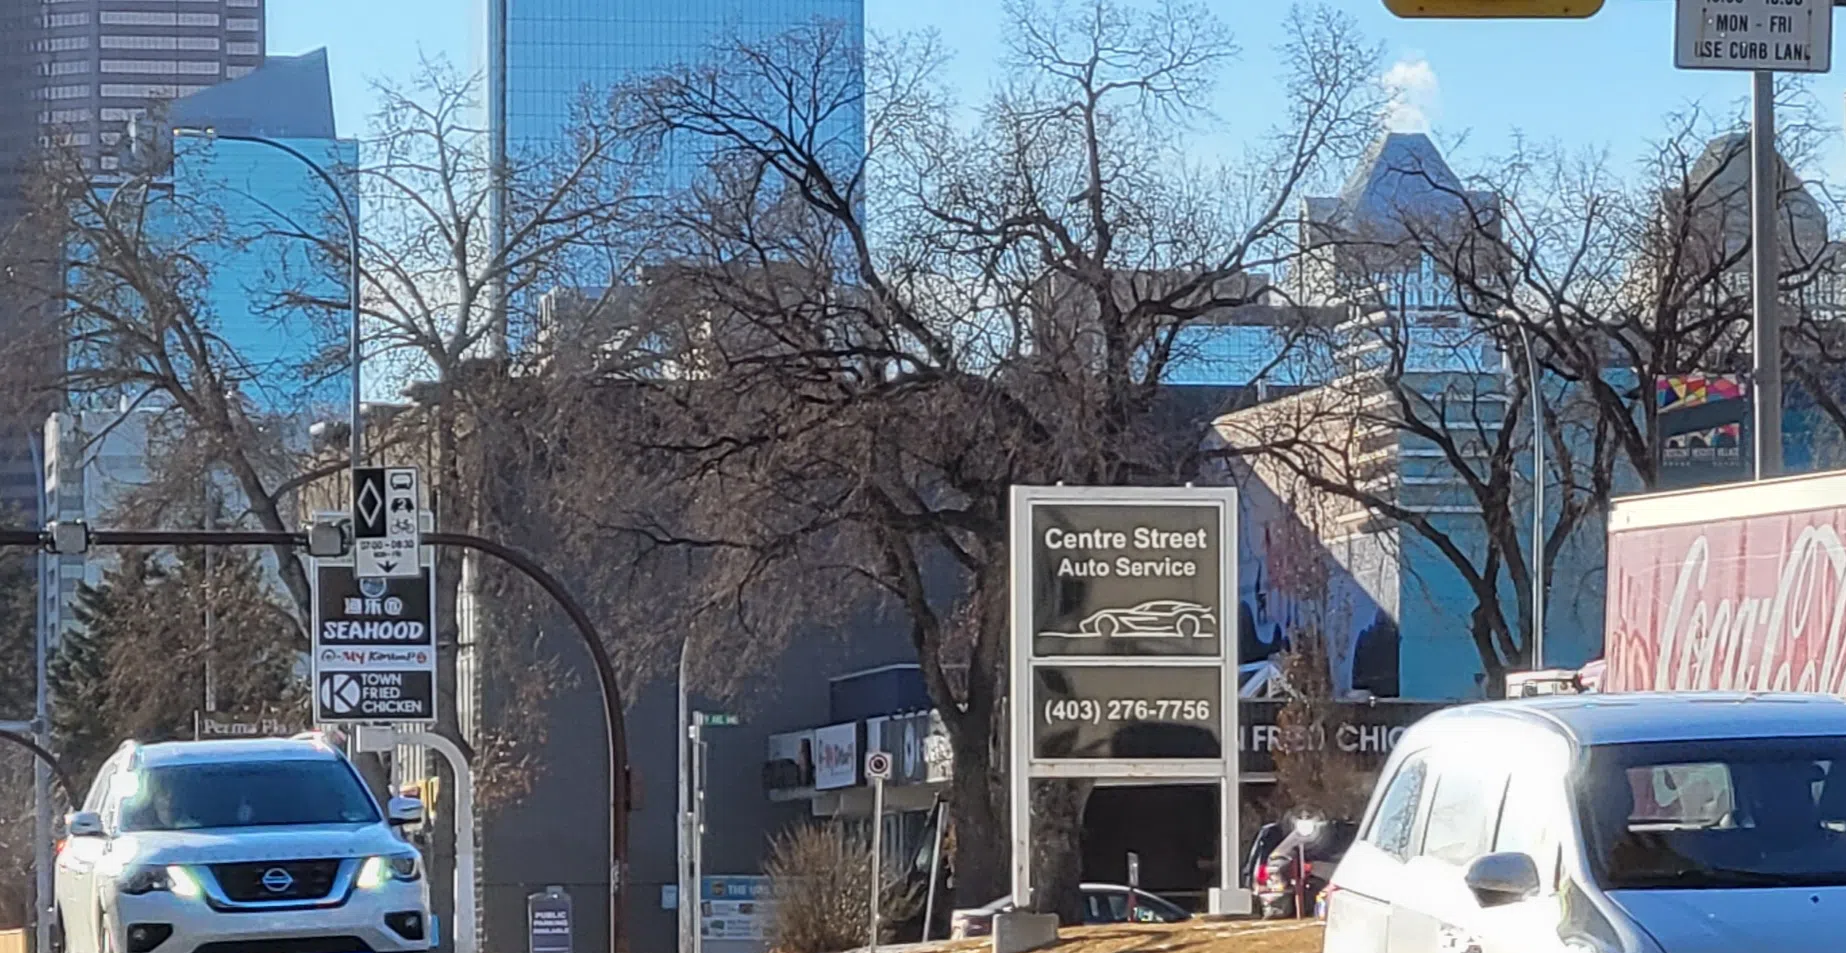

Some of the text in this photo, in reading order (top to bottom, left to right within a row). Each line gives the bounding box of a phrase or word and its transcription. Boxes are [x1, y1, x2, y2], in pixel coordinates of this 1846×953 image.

[1716, 14, 1748, 32] MON
[1769, 15, 1792, 33] FRI
[1694, 41, 1722, 58] USE
[1729, 42, 1768, 59] CURB
[1045, 527, 1207, 549] Centre Street
[1057, 557, 1196, 576] Auto Service
[323, 621, 424, 639] SEAHOOD
[361, 673, 402, 685] TOWN
[362, 687, 400, 699] FRIED
[362, 701, 423, 713] CHICKEN
[1045, 699, 1210, 725] (403) 276-7756
